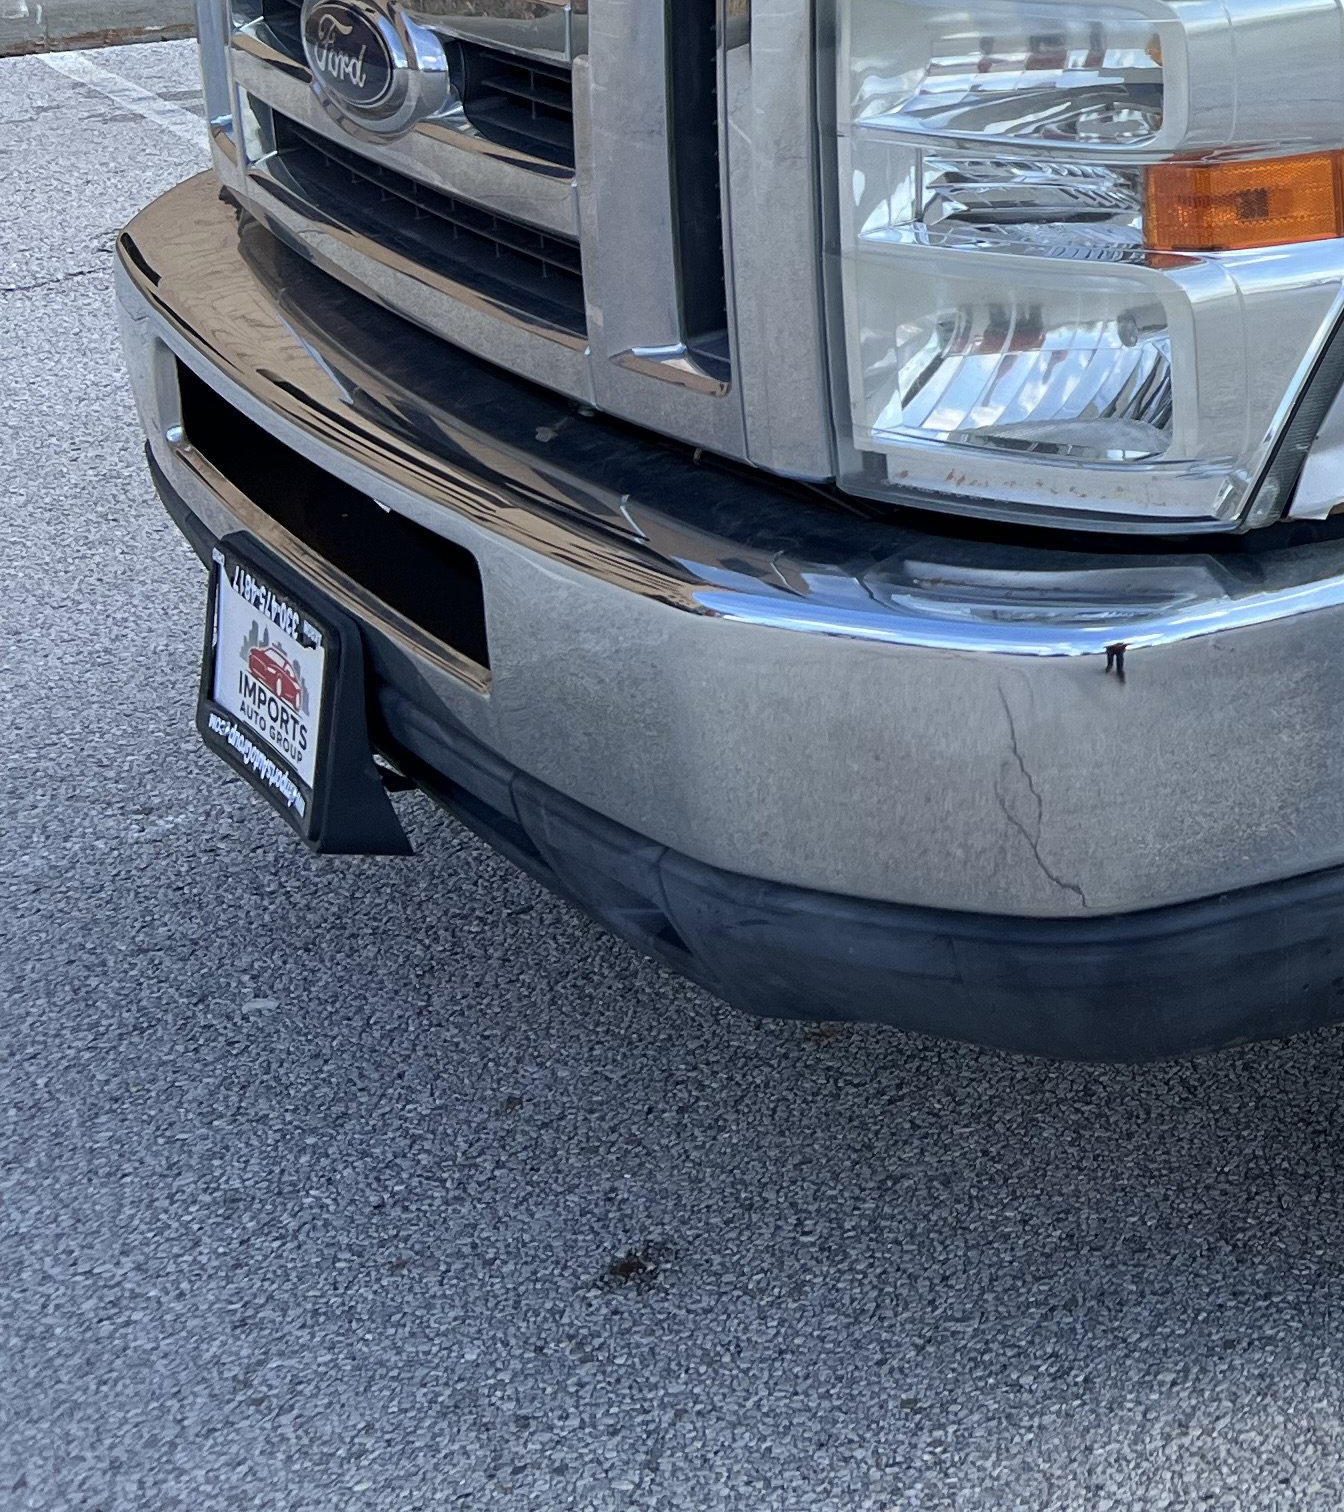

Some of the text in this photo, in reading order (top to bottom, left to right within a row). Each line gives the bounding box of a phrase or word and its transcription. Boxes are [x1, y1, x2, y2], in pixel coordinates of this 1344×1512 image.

[314, 13, 367, 88] Ford
[238, 670, 308, 751] IMPORTS
[240, 700, 303, 763] AUTO GROUP
